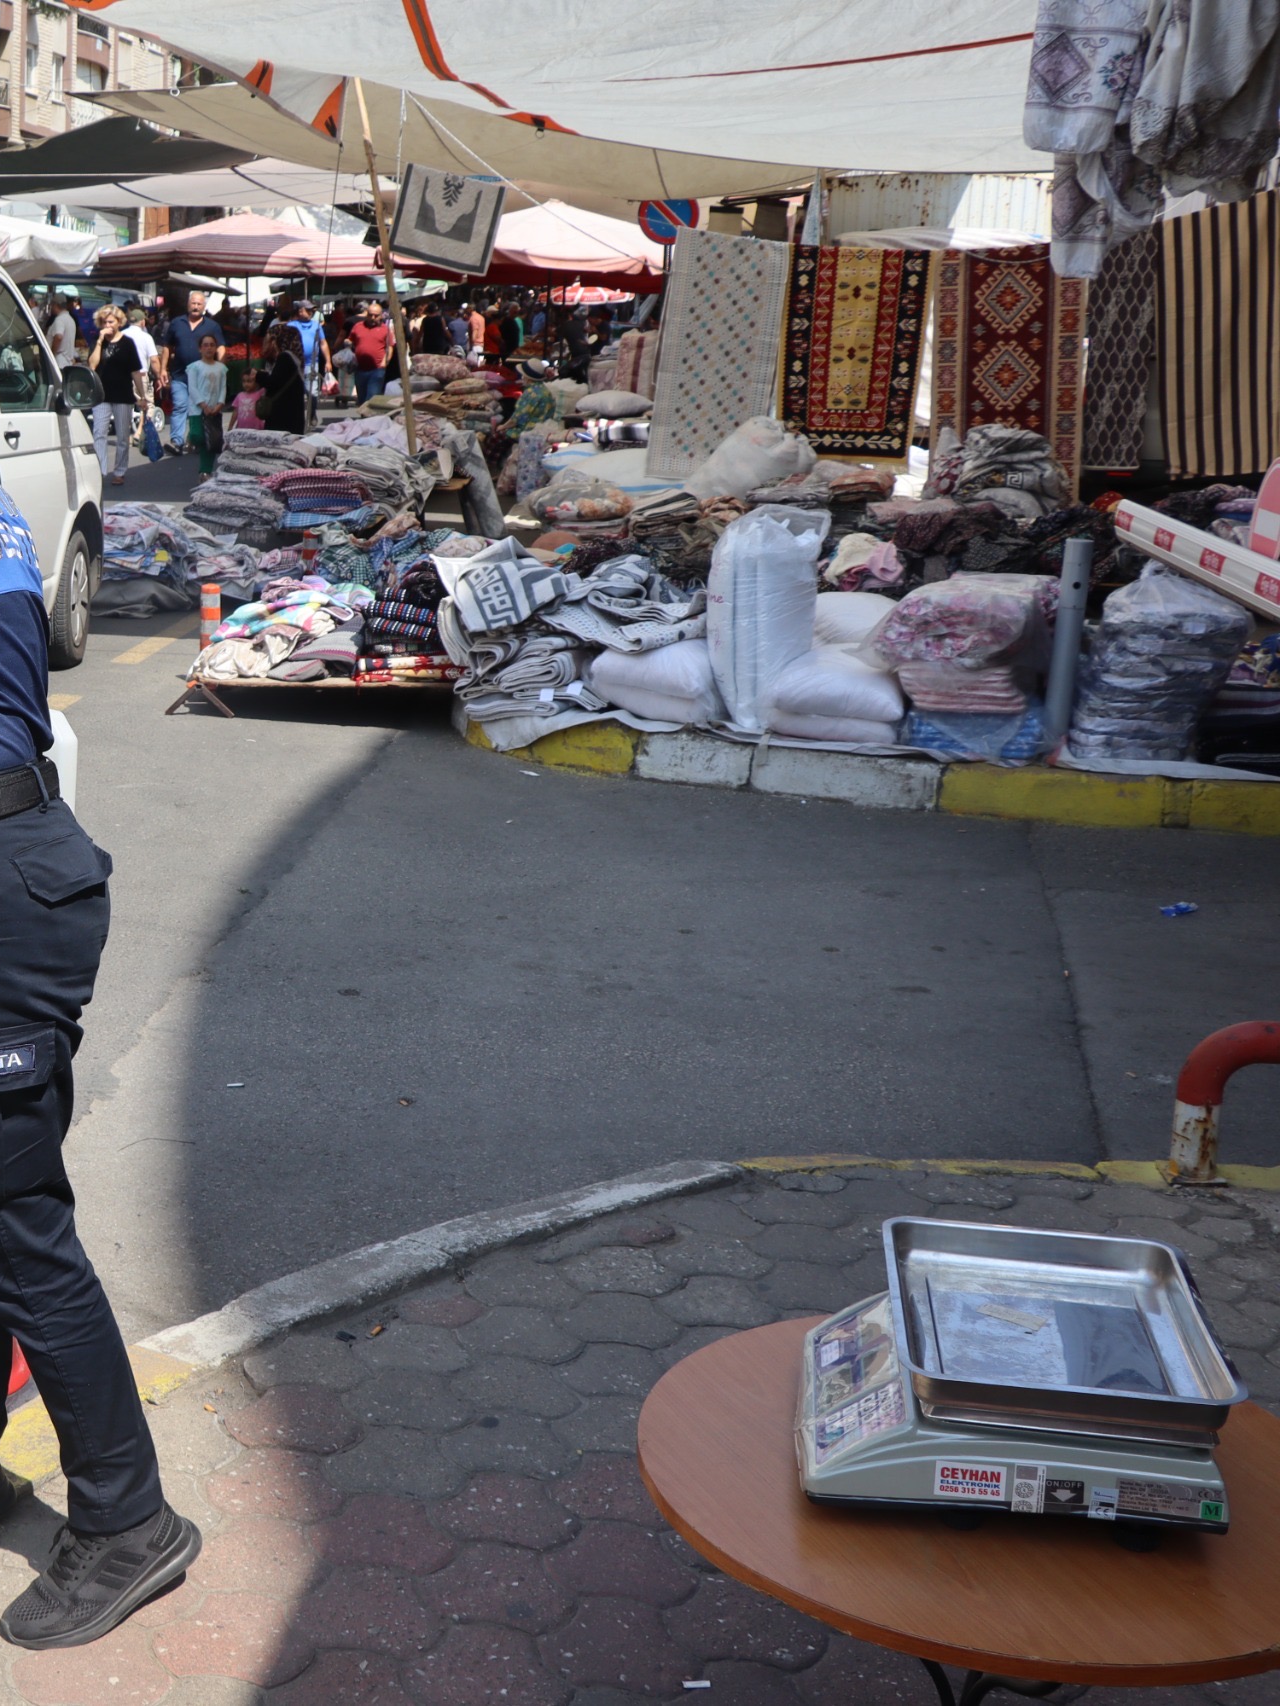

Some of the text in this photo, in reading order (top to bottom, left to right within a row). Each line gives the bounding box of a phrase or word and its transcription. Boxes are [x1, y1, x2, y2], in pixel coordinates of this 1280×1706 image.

[940, 1467, 1001, 1483] CEYHAN
[939, 1485, 959, 1493] 0256
[961, 1486, 976, 1495] 315
[978, 1488, 988, 1496] 55
[1204, 1505, 1220, 1516] M
